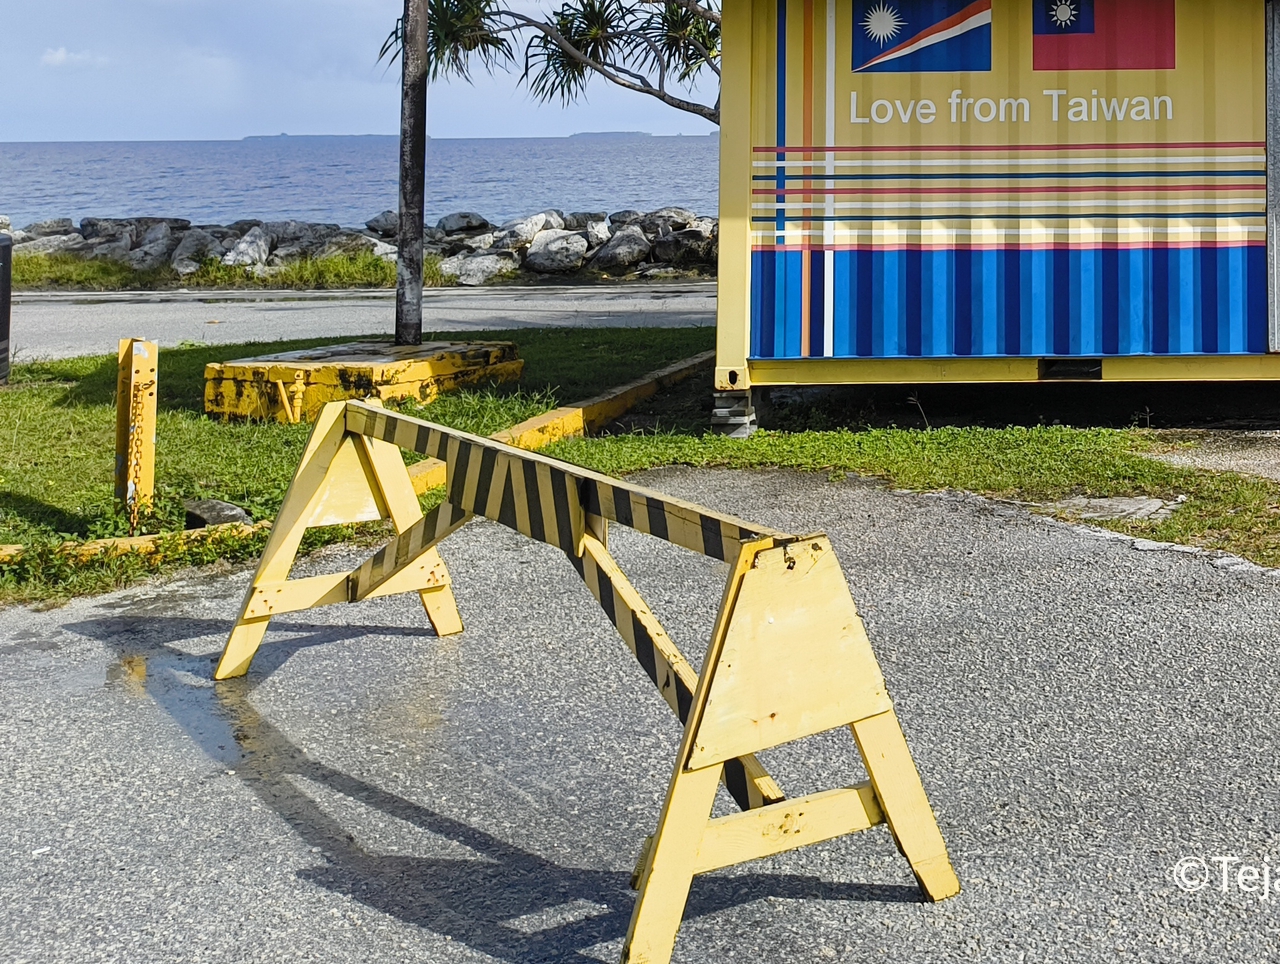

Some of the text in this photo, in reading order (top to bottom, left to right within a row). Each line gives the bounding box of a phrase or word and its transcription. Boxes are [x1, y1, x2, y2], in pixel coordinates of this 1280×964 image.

[850, 89, 1173, 123] Love from Taiwan
